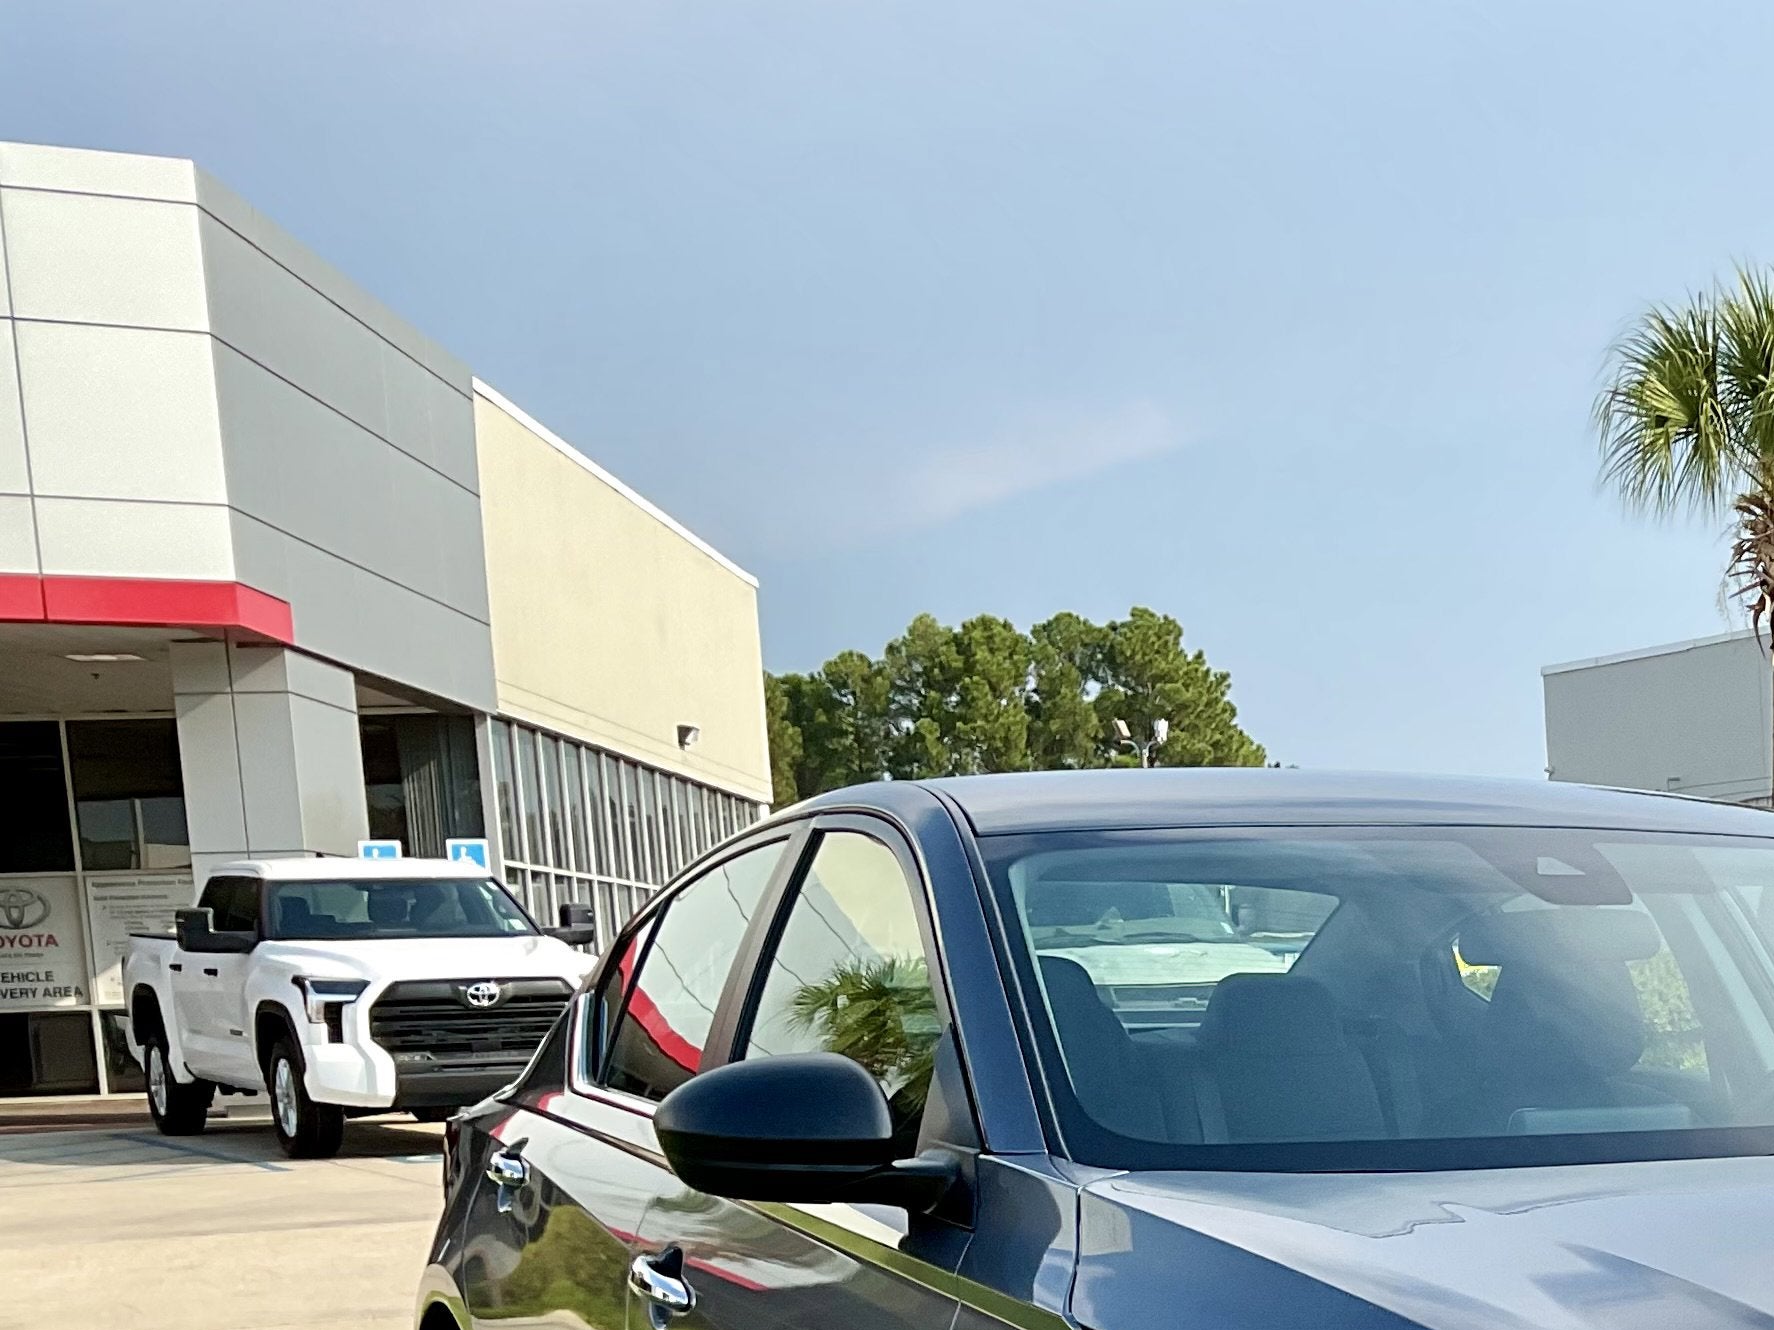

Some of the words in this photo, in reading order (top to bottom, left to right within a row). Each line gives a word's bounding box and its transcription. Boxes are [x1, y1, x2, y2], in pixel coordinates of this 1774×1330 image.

[0, 934, 59, 948] YOTA
[0, 971, 54, 983] EHICLE
[0, 988, 37, 999] VERY
[43, 986, 83, 998] AREA
